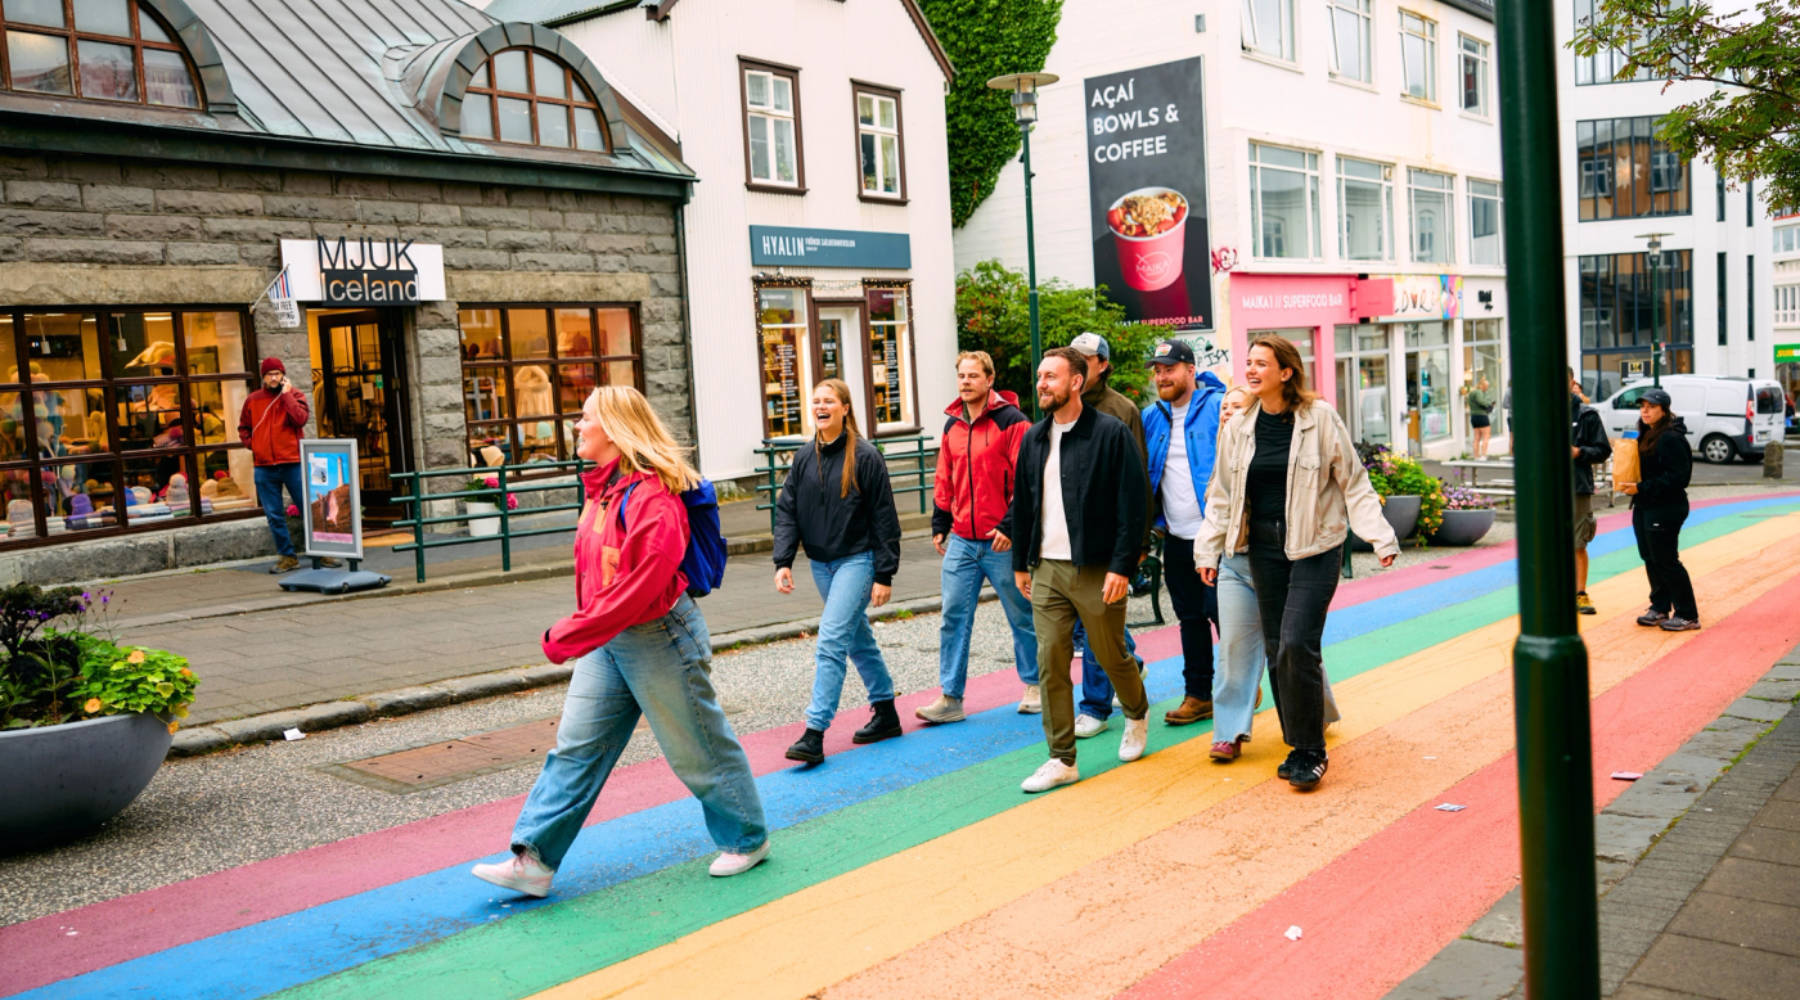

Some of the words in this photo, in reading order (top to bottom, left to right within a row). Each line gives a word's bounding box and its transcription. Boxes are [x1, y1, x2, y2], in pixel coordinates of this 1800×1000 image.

[1091, 78, 1135, 109] AÇAÍ
[1093, 107, 1160, 136] BOWLS
[1164, 103, 1180, 123] &
[1094, 135, 1168, 163] COFFEE
[317, 235, 418, 273] MJUK
[762, 235, 806, 257] HYALIN
[320, 272, 421, 301] Iceland
[1283, 293, 1328, 309] SUPERFOOD
[1329, 293, 1343, 306] BAR
[1188, 315, 1204, 323] BAR
